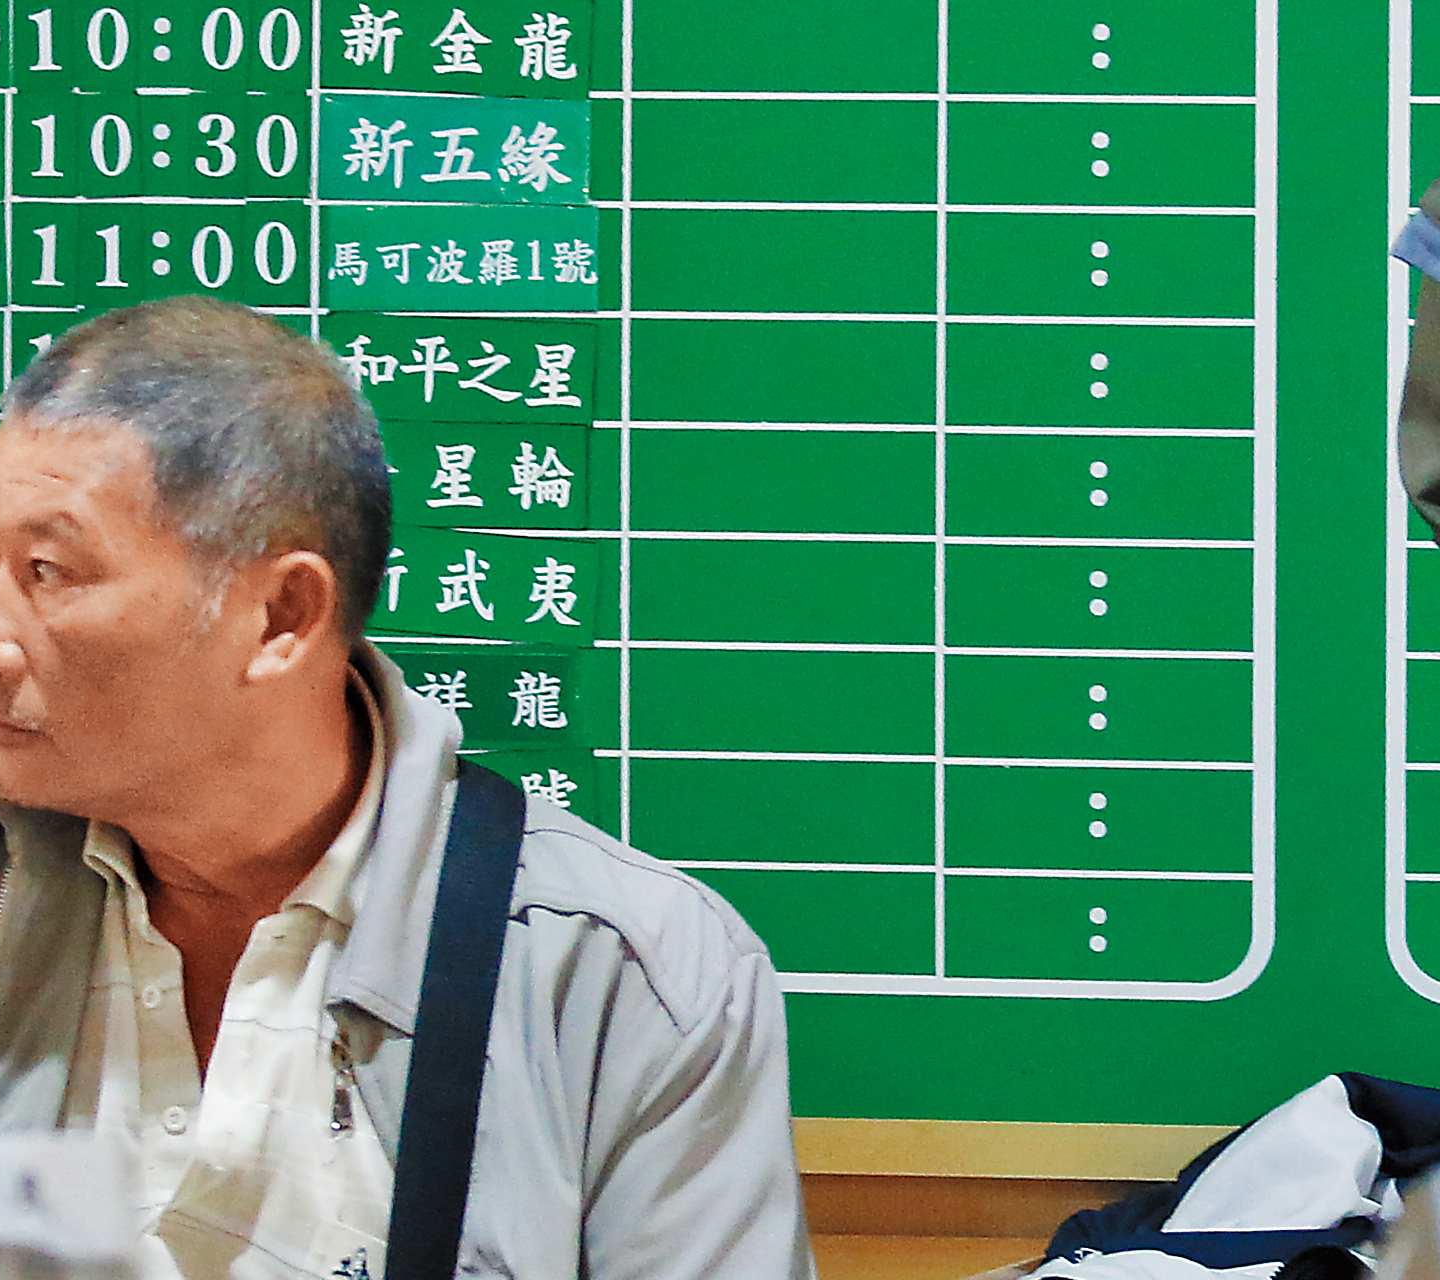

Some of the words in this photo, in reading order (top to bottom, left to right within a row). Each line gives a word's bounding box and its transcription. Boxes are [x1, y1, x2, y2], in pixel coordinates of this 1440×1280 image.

[28, 8, 300, 70] 10:00
[341, 4, 577, 80] 新金龍
[32, 114, 297, 176] 10:30
[343, 119, 572, 191] 新五緣
[32, 222, 296, 288] 11:00
[328, 239, 600, 286] 馬可波羅1號
[344, 335, 582, 408] 和平之星
[388, 441, 574, 510] 星輪
